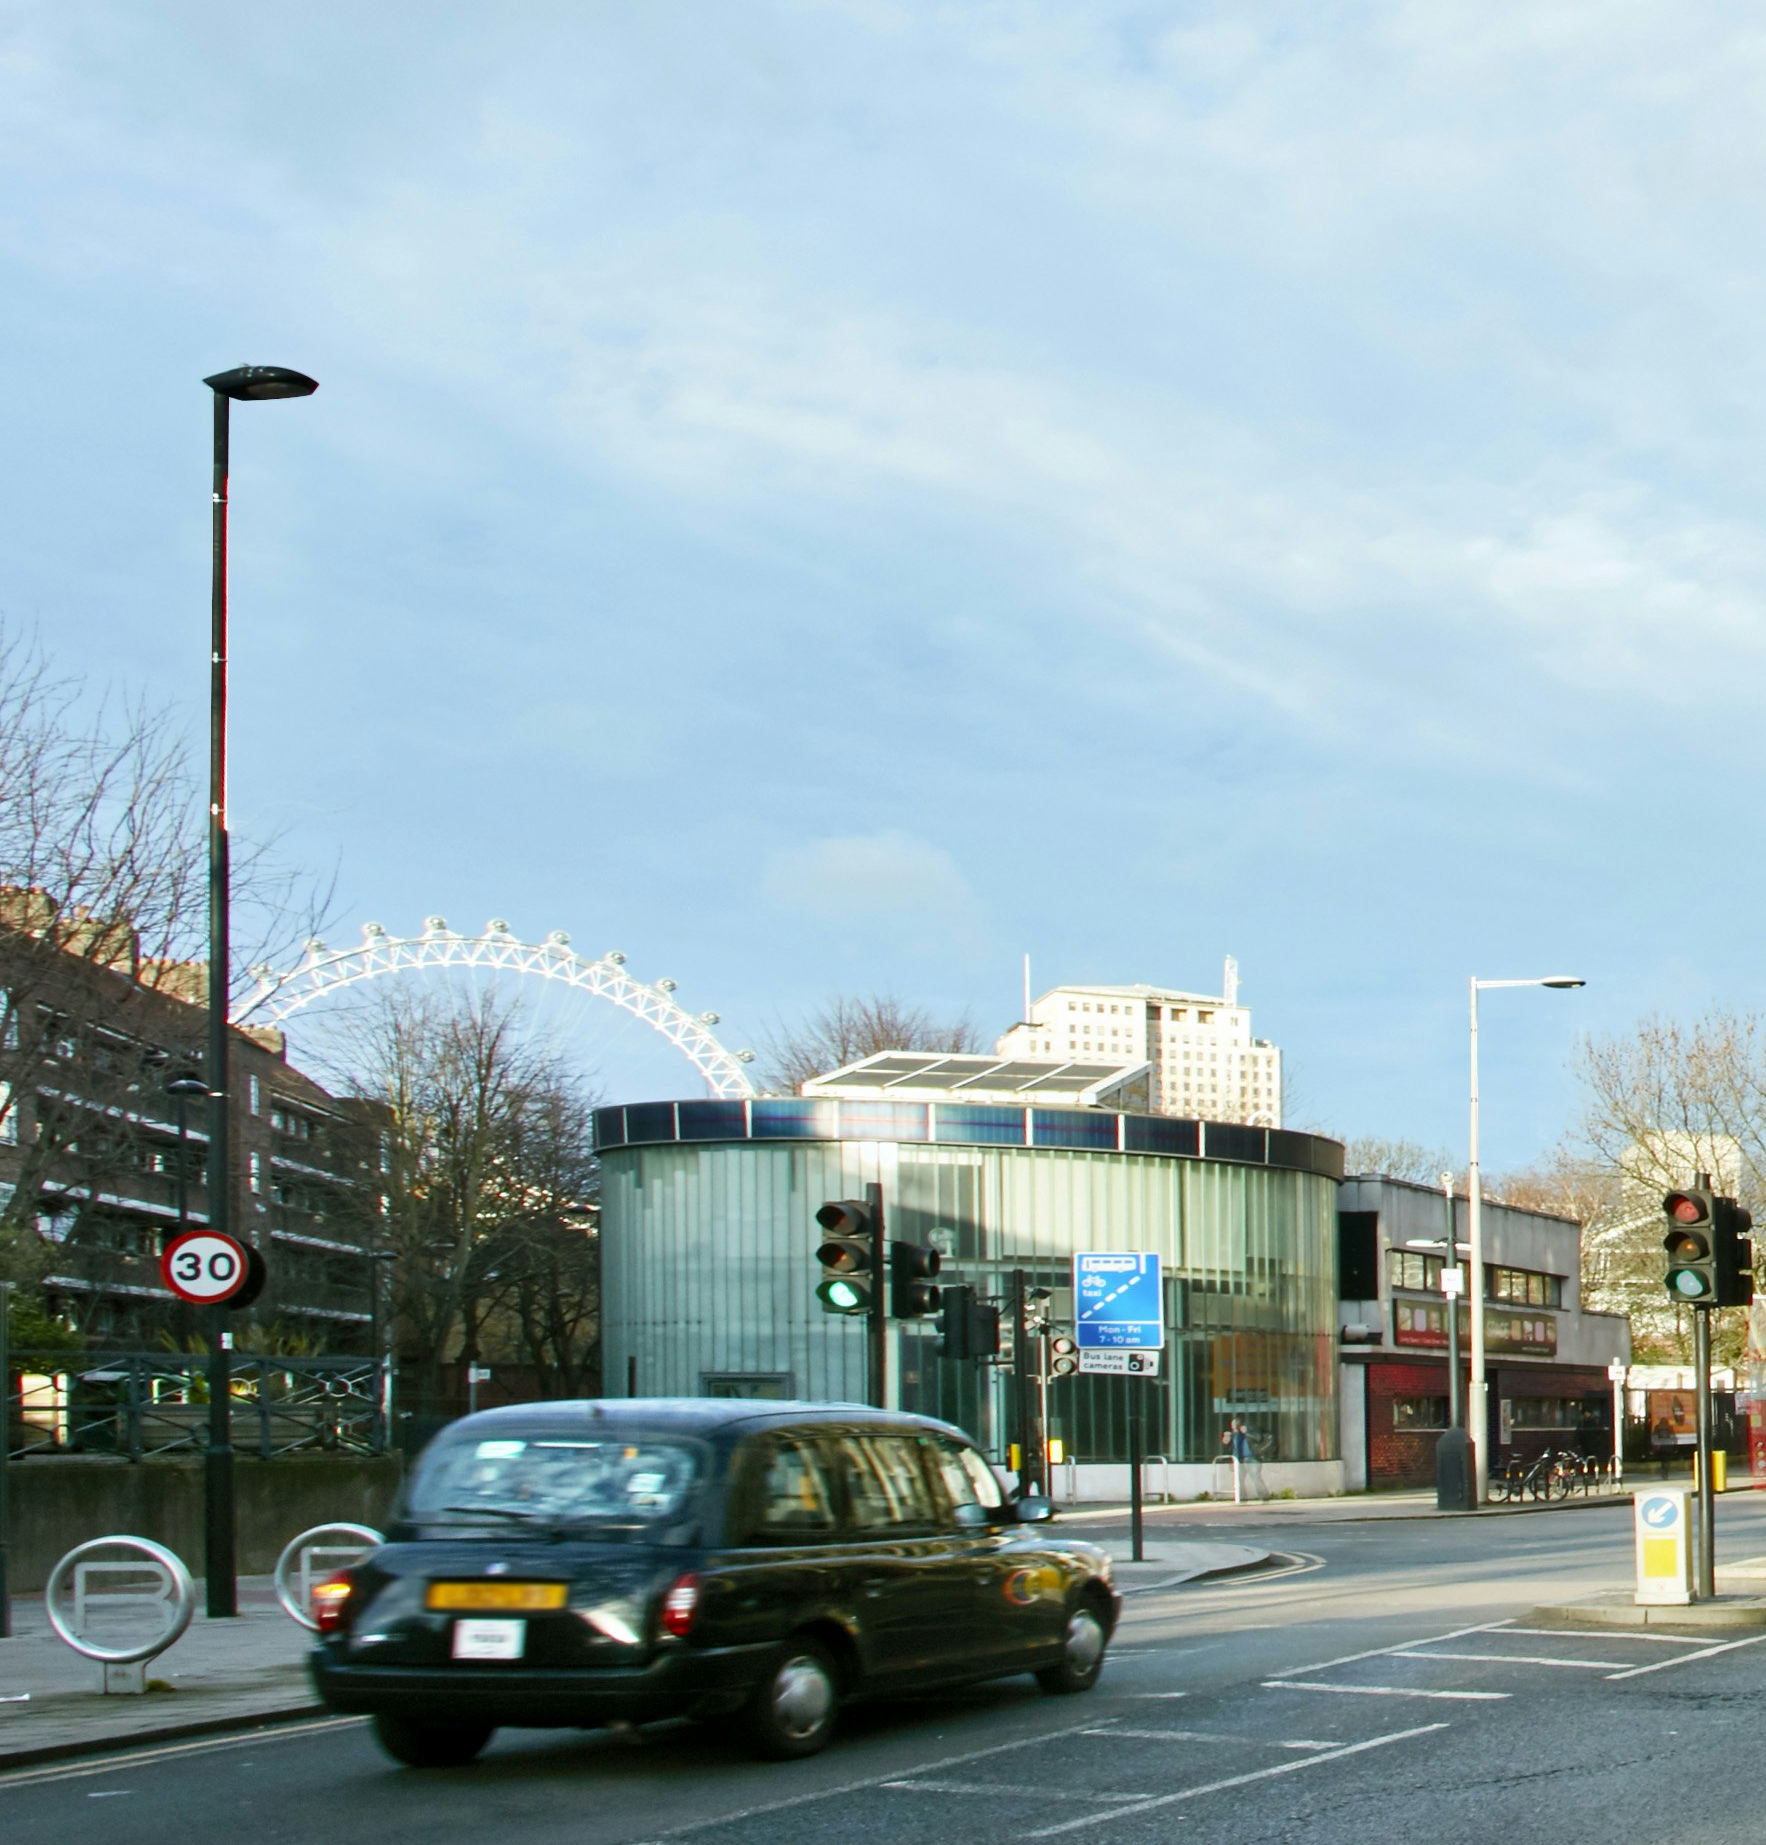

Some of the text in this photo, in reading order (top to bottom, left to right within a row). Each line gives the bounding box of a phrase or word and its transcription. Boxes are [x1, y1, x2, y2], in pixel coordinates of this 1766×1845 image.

[177, 1252, 236, 1281] 30
[1082, 1289, 1101, 1297] taxi
[1084, 1352, 1124, 1361] Bus lane
[1083, 1362, 1123, 1370] cameras
